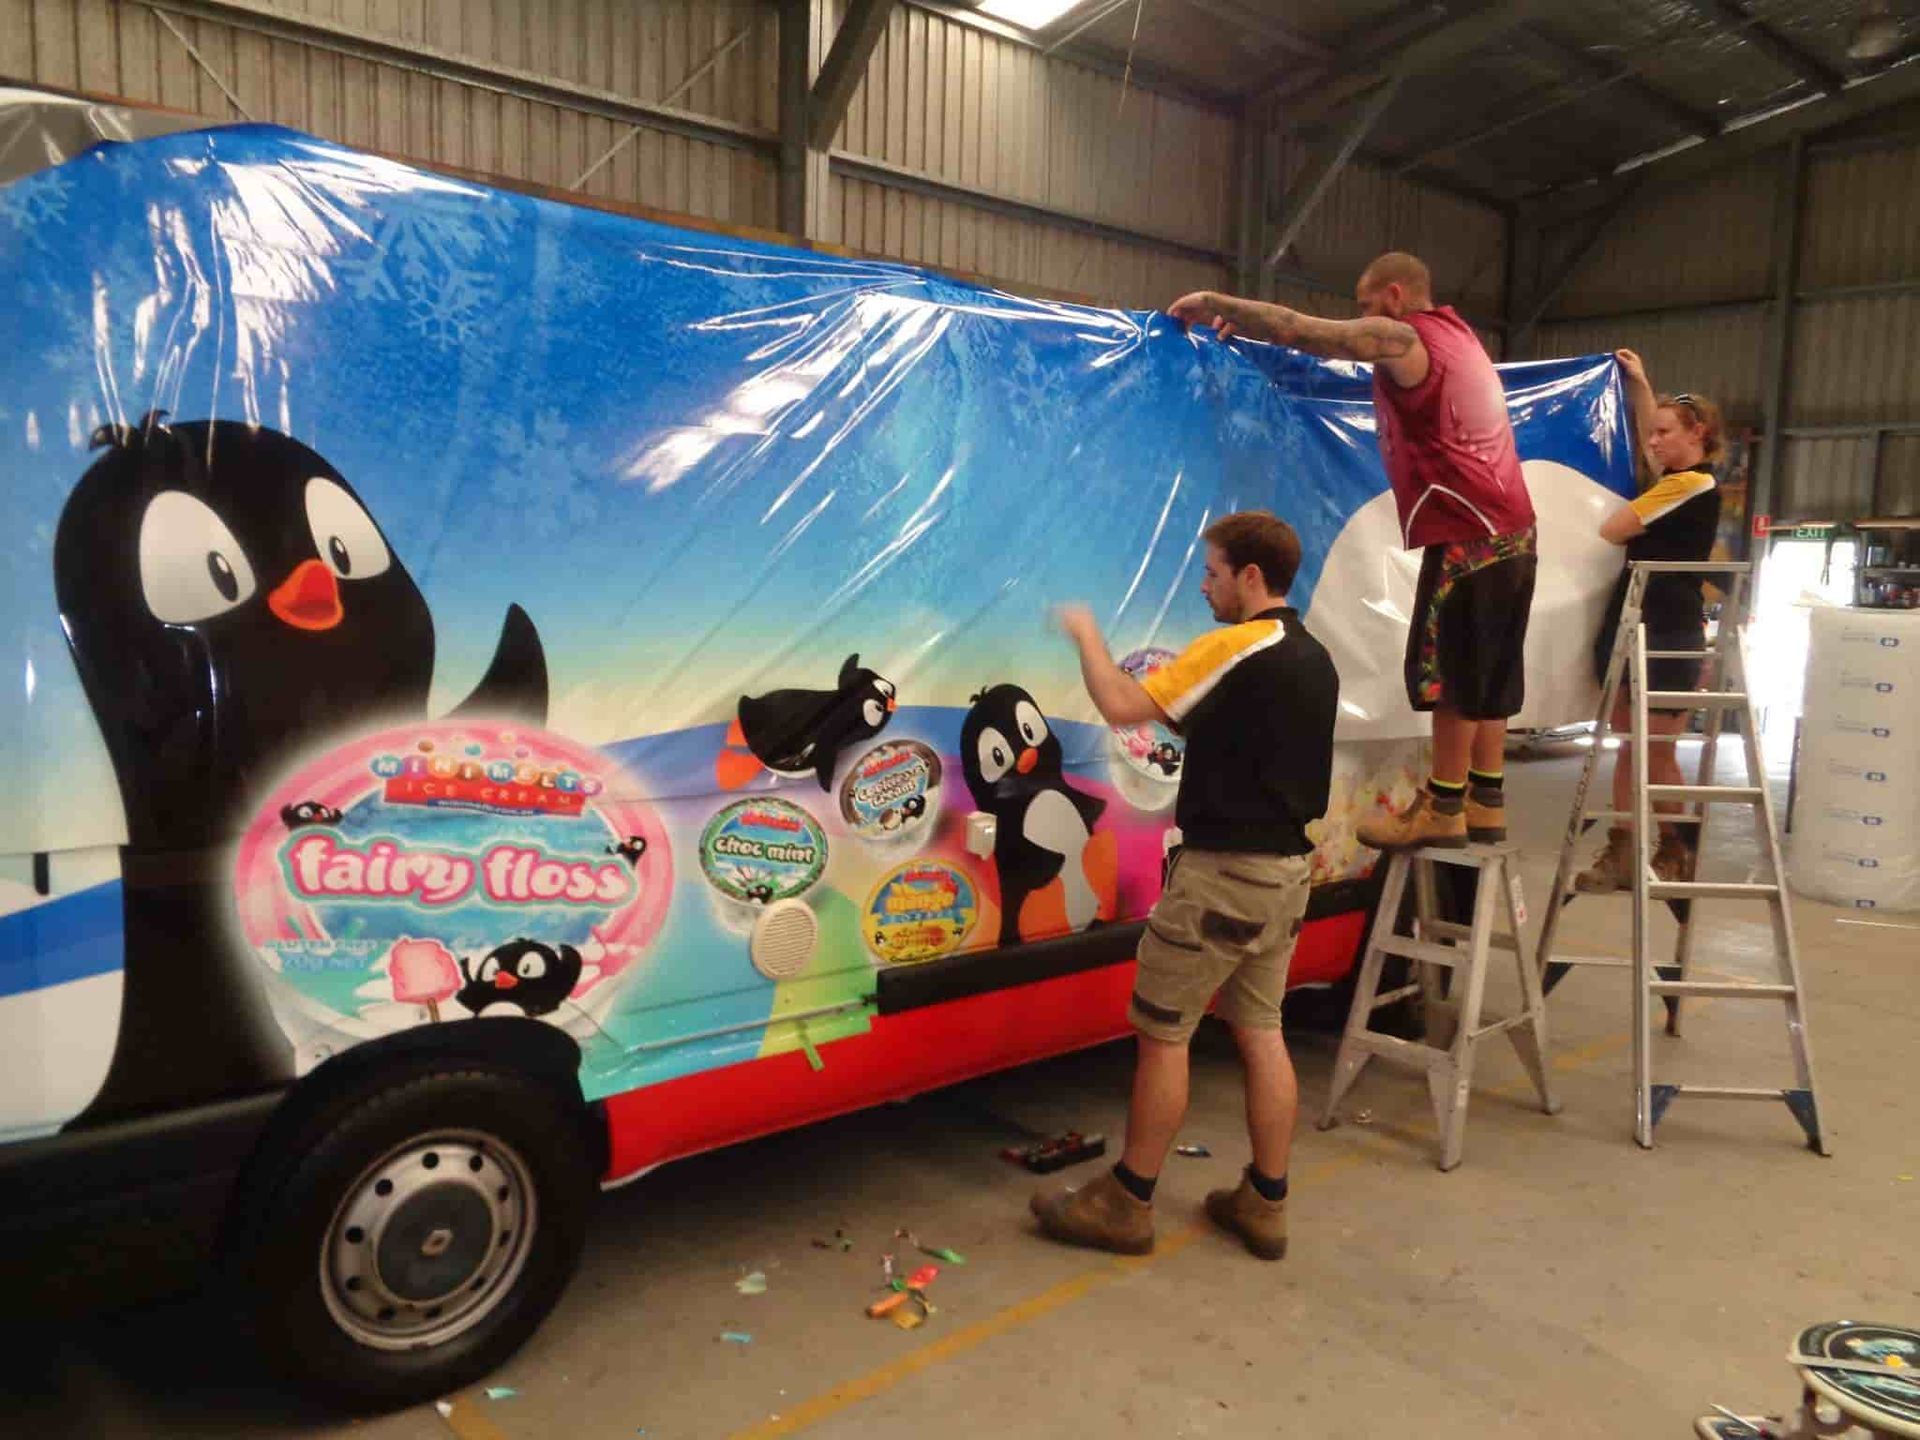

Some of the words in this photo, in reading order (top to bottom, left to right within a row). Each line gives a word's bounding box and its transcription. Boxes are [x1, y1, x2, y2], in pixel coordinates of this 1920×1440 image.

[1796, 527, 1825, 538] EXIT
[374, 754, 480, 779] MINI
[488, 763, 600, 795] MELTS
[406, 780, 455, 797] ICE
[480, 787, 571, 804] CREAM
[767, 844, 814, 863] mint
[293, 837, 474, 902] fairy
[484, 846, 629, 901] floss
